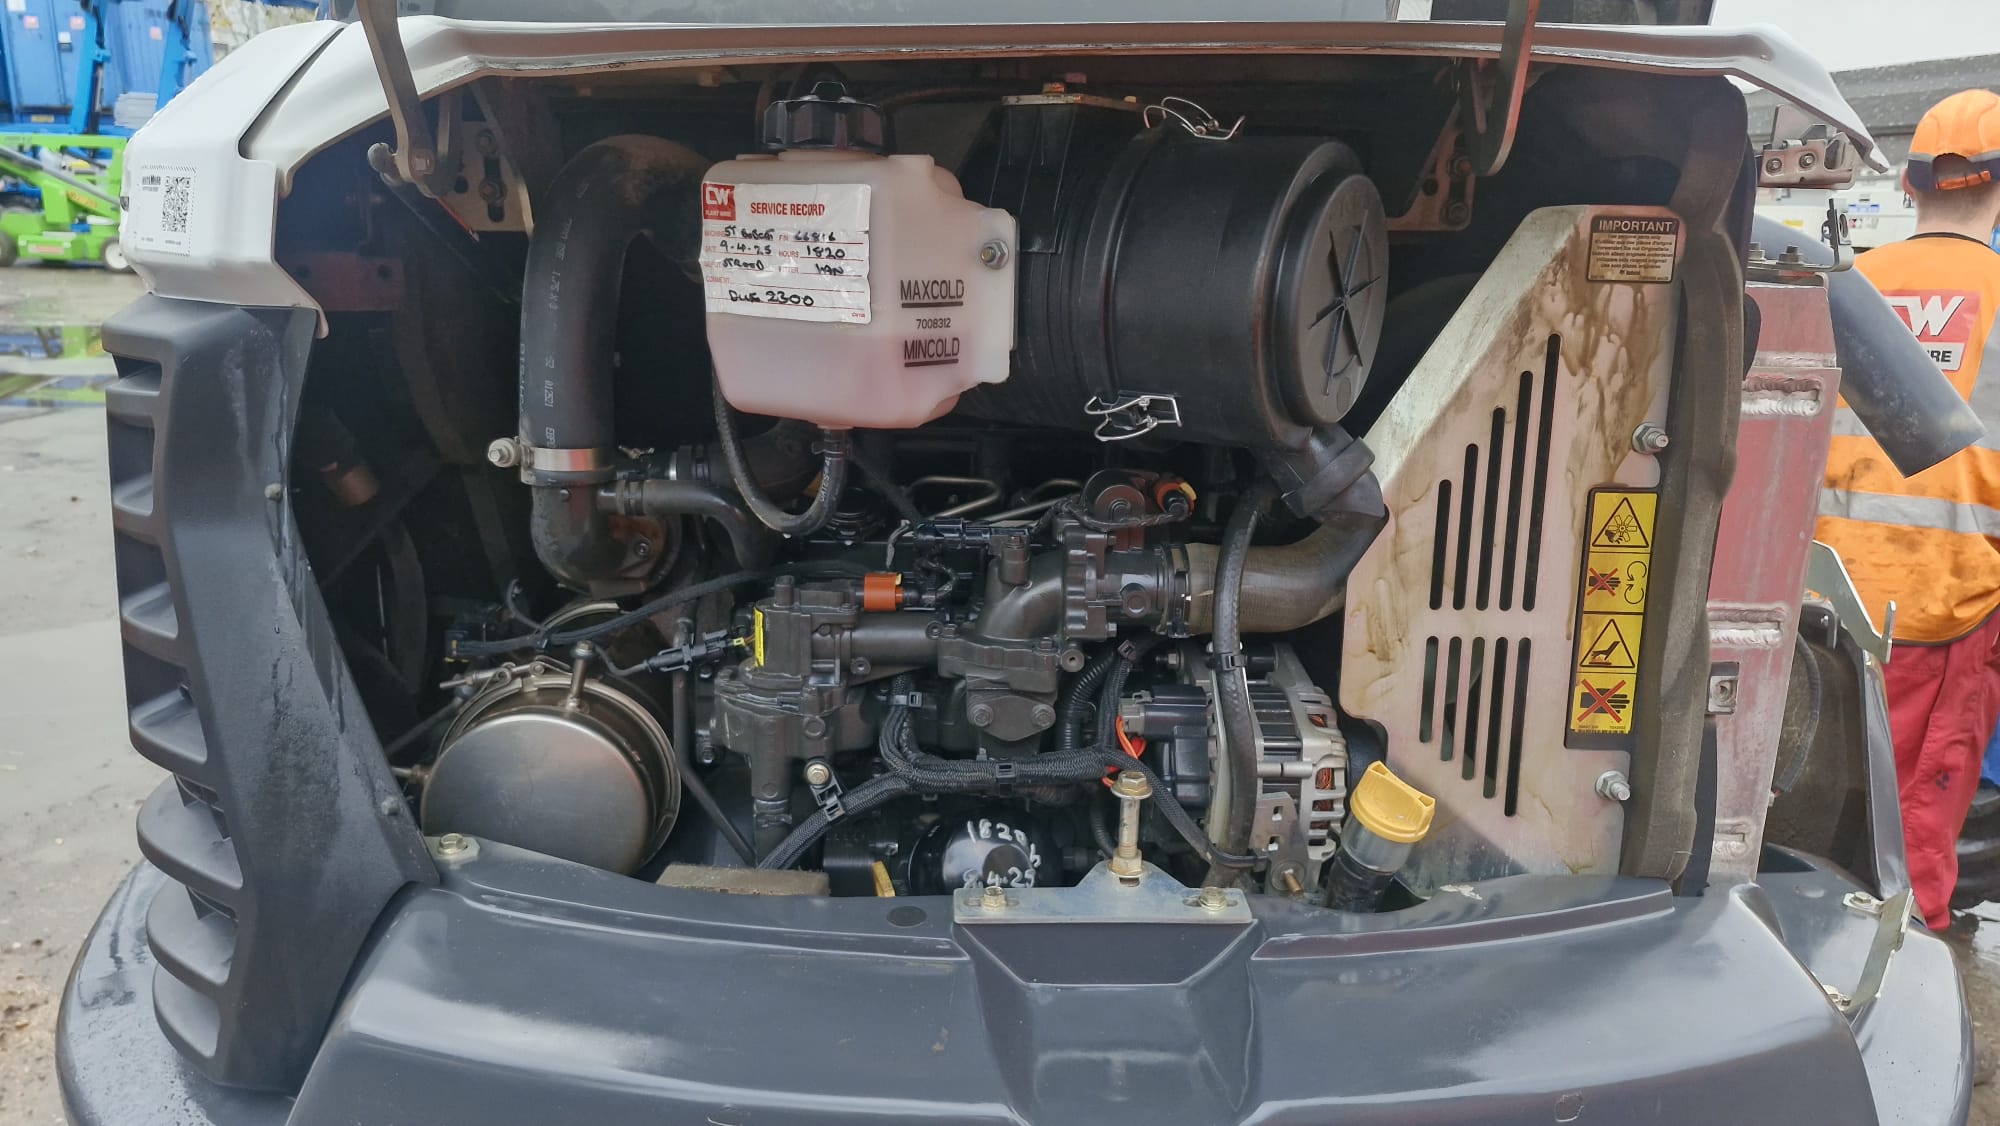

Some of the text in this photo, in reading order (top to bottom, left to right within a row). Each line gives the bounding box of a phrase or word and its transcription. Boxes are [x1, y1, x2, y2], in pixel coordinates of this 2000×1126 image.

[706, 187, 730, 206] CW
[750, 202, 825, 216] SERVICE RECORD
[1599, 219, 1672, 232] IMPORTANT
[806, 245, 846, 260] 1820
[900, 279, 964, 300] MAXCOLD
[765, 290, 815, 307] 2300
[916, 318, 951, 330] 7008312
[904, 337, 960, 361] MINCOLD
